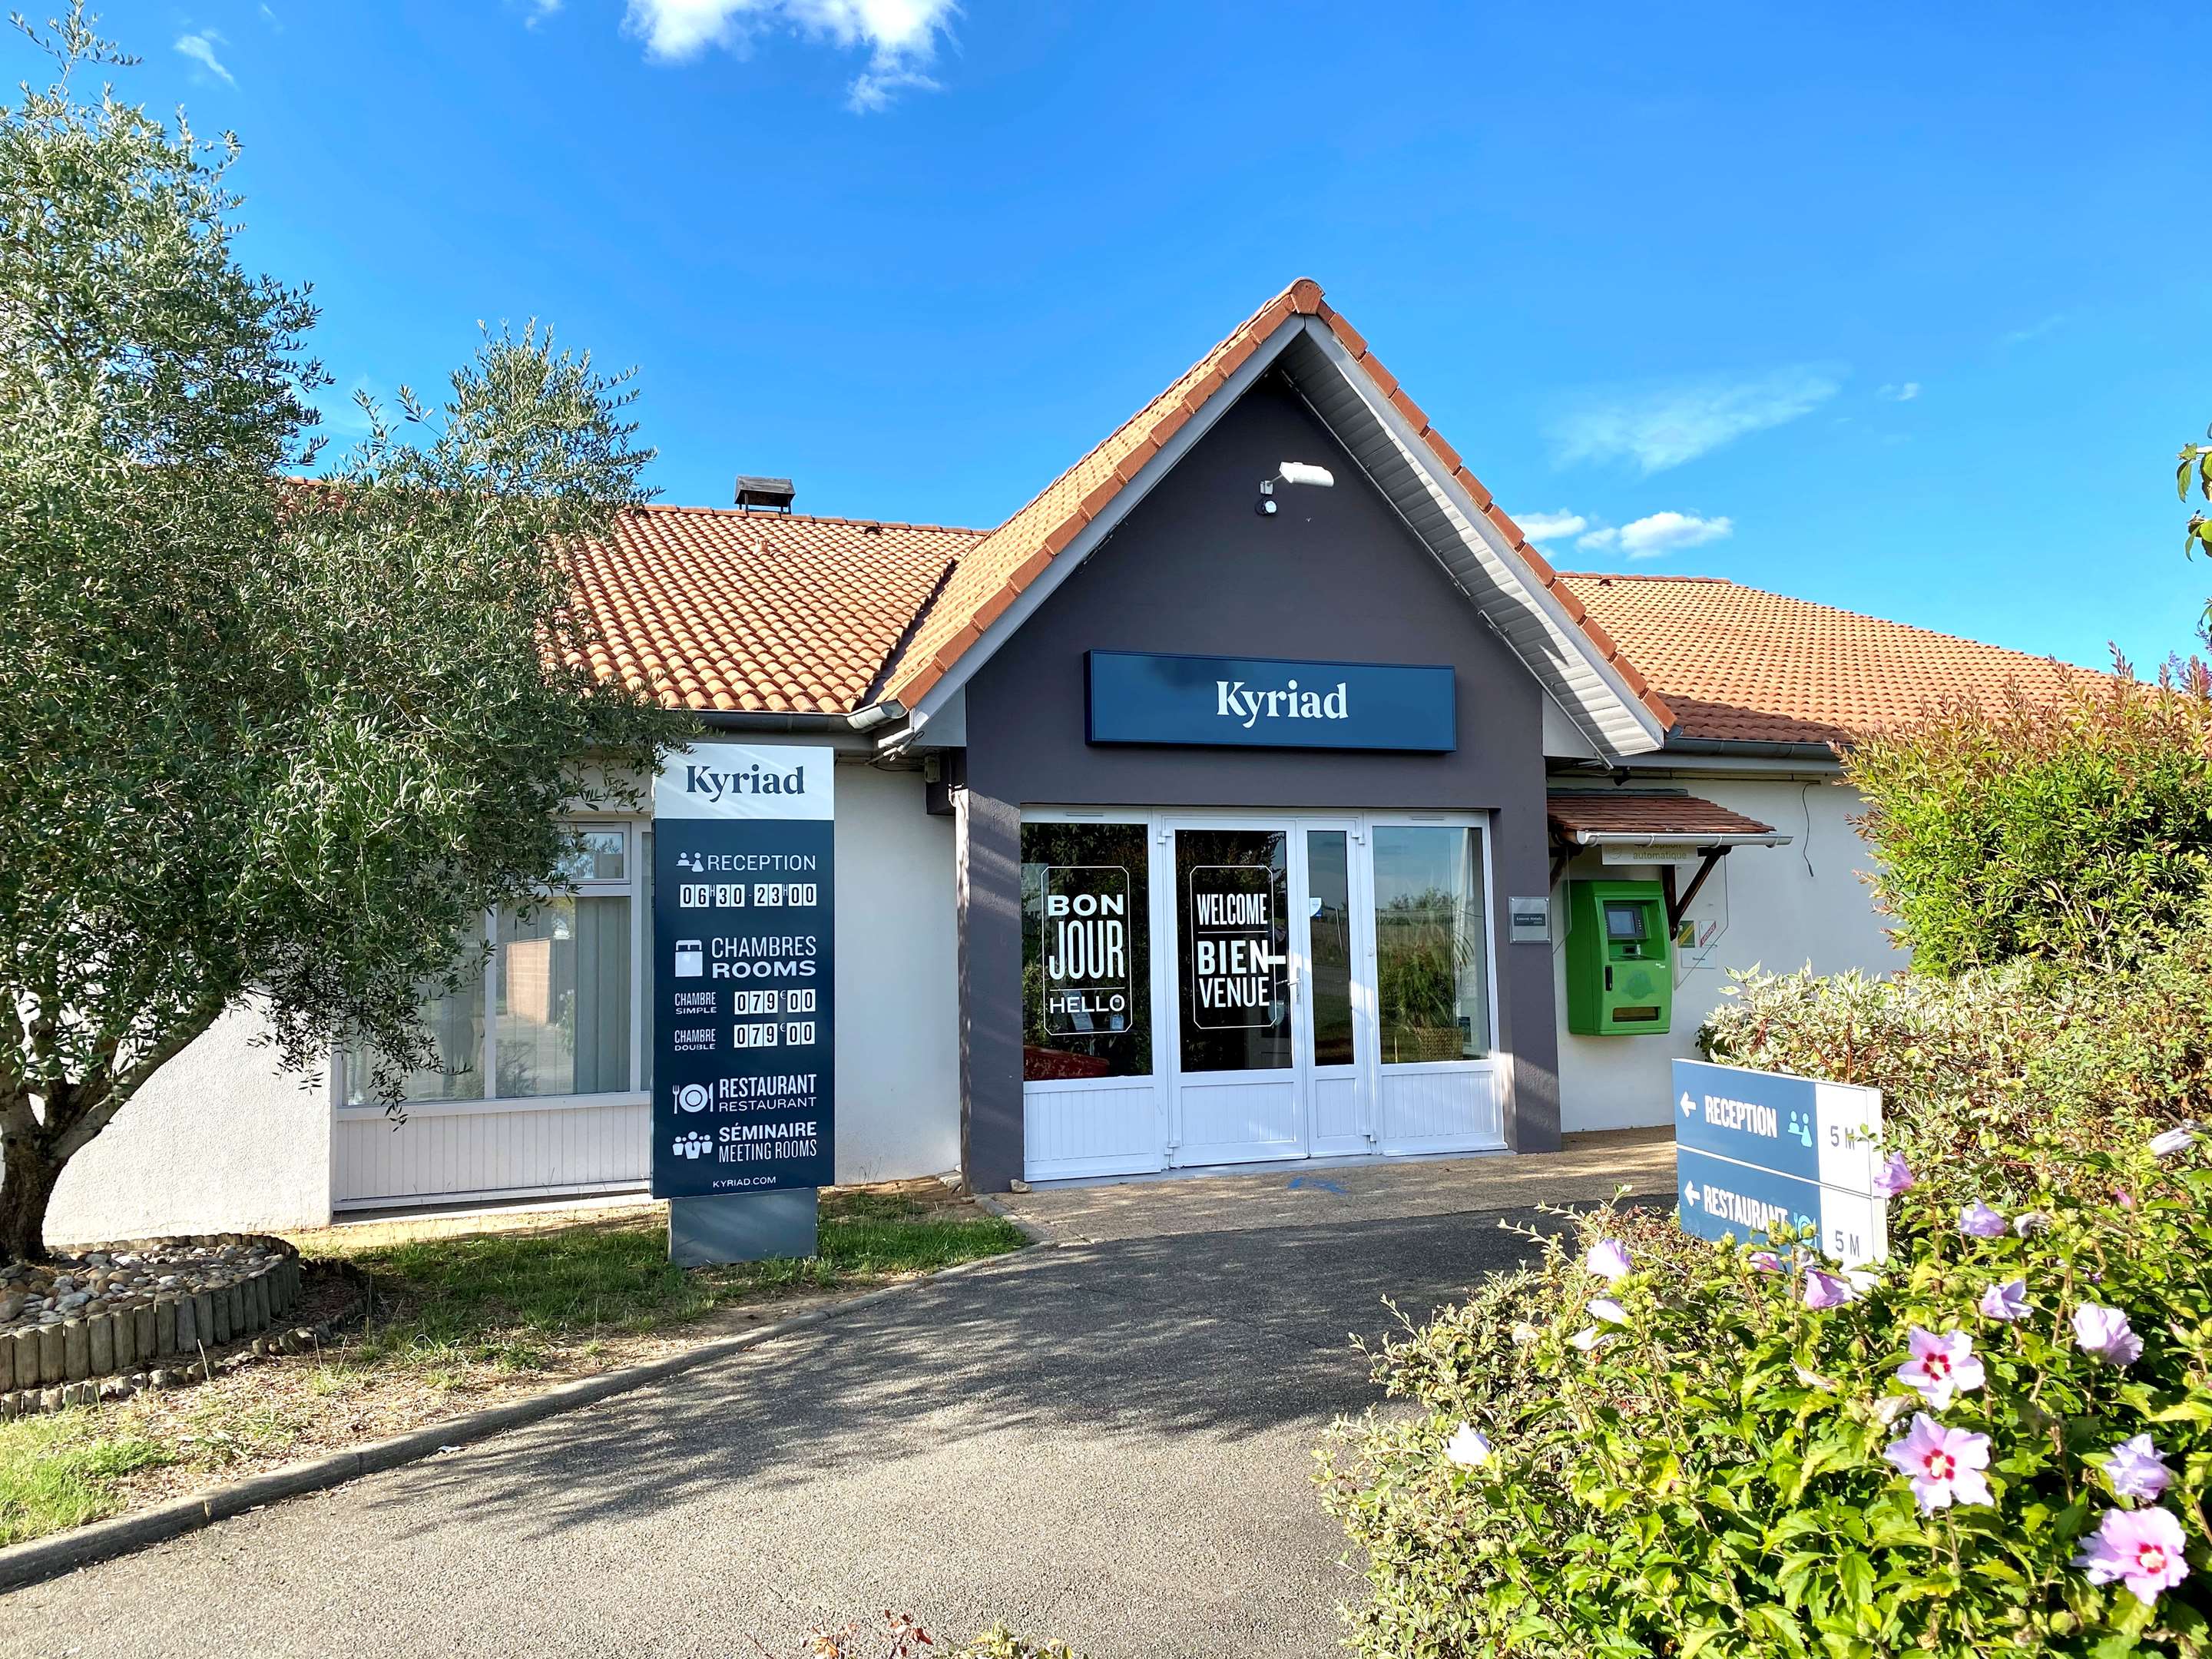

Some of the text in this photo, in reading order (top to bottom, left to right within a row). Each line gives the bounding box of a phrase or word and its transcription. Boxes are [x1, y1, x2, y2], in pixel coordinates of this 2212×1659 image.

[1216, 679, 1349, 729] Kyriad
[686, 764, 806, 803] Kyriad
[707, 855, 816, 871] RECEPTION
[1634, 851, 1687, 860] automatique
[1047, 894, 1124, 916] BON
[1197, 893, 1268, 926] WELCOME
[711, 936, 816, 959] CHAMBRES
[1048, 920, 1125, 980] JOUR
[712, 960, 816, 979] ROOMS
[674, 992, 717, 1006] CHAMBRE
[1198, 976, 1270, 1008] VENUE
[675, 1006, 717, 1015] SIMPLE
[1050, 994, 1125, 1014] HELLO
[674, 1028, 717, 1044] CHAMBRE
[674, 1043, 716, 1051] DOUBLE
[719, 1074, 817, 1099] RESTAURANT
[719, 1097, 817, 1113] RESTAURANT
[1704, 1094, 1777, 1138] RECEPTION
[719, 1121, 817, 1142] SÉMINAIRE
[1830, 1125, 1839, 1147] 5
[719, 1138, 817, 1163] MEETING ROOMS
[713, 1176, 777, 1188] KYRIAD.COM
[1835, 1230, 1860, 1258] 5 M
